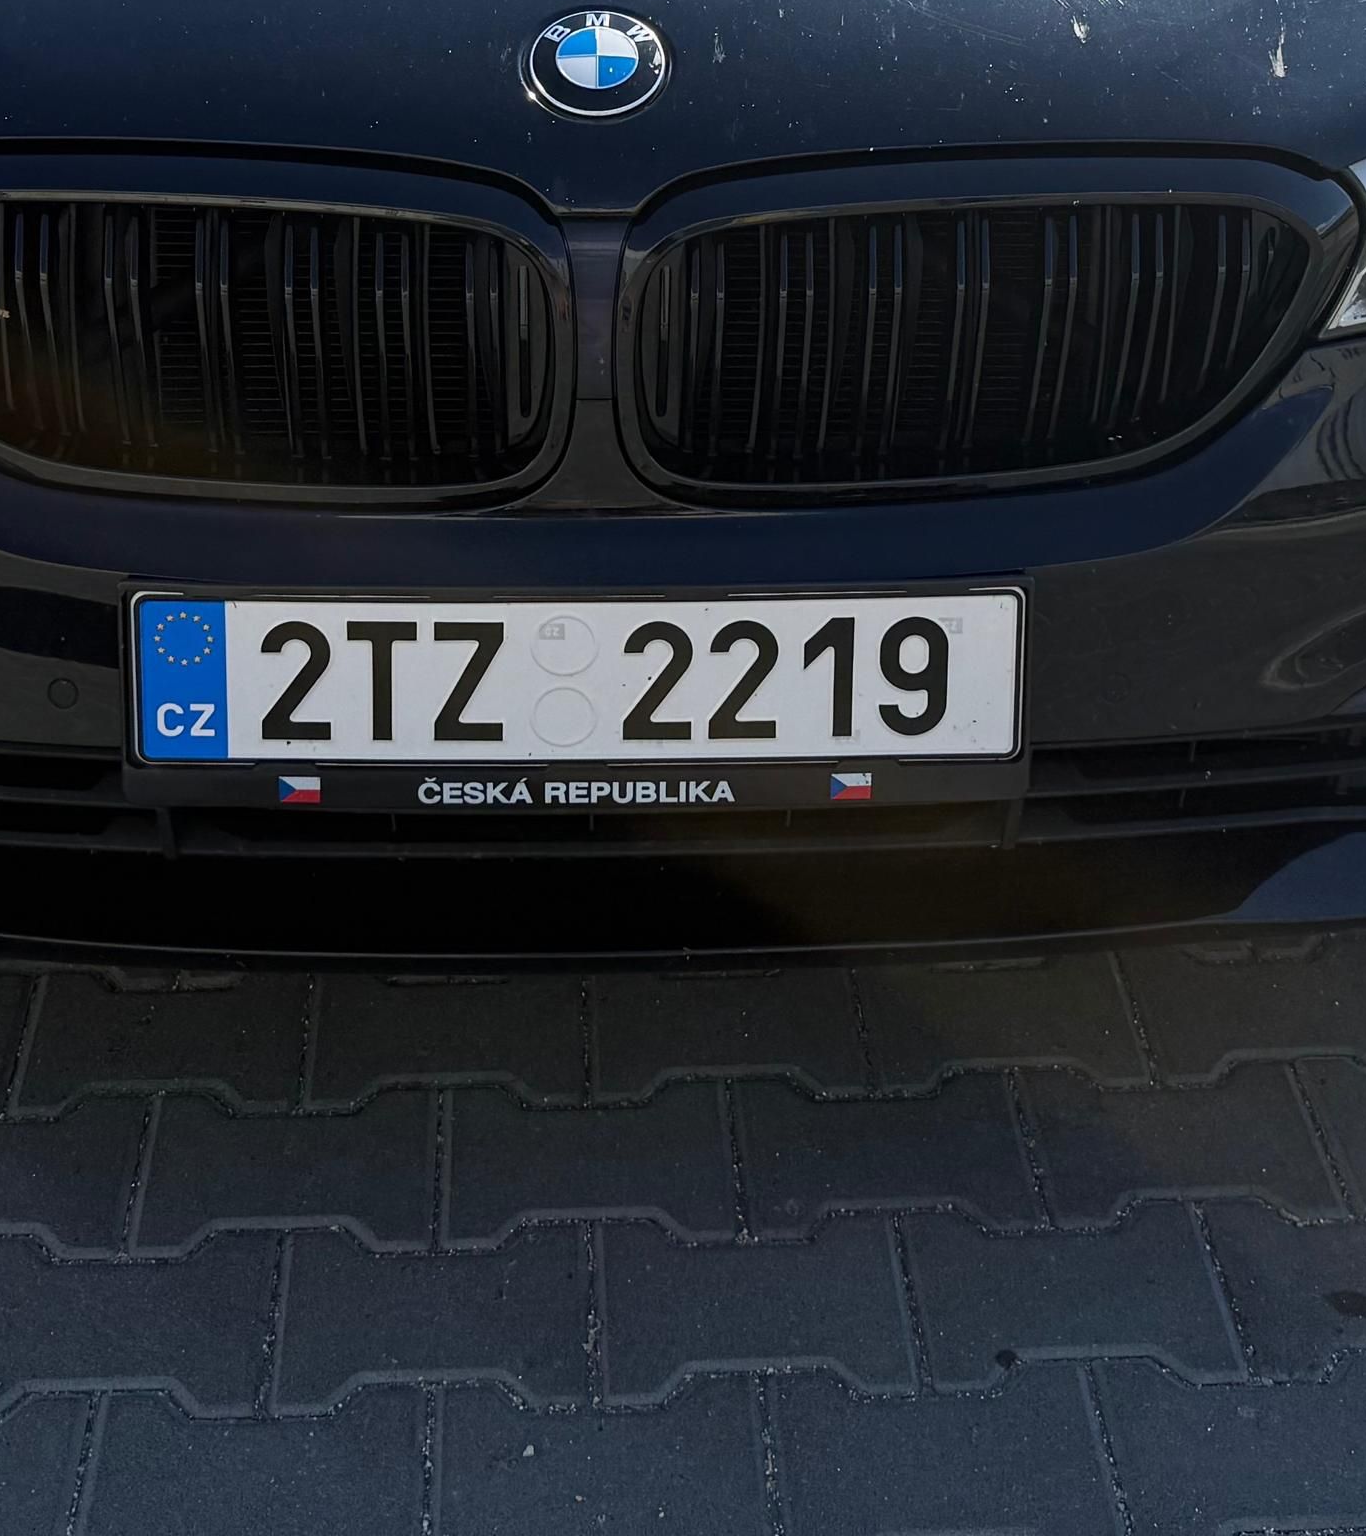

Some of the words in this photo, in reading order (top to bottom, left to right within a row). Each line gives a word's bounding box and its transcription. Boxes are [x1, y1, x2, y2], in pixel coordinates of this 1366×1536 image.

[544, 13, 653, 43] BMW
[260, 620, 505, 742] 2TZ
[622, 616, 950, 741] 2219
[155, 702, 216, 737] CZ
[417, 777, 534, 805] ČESKÁ
[543, 780, 736, 804] REPUBLIKA
